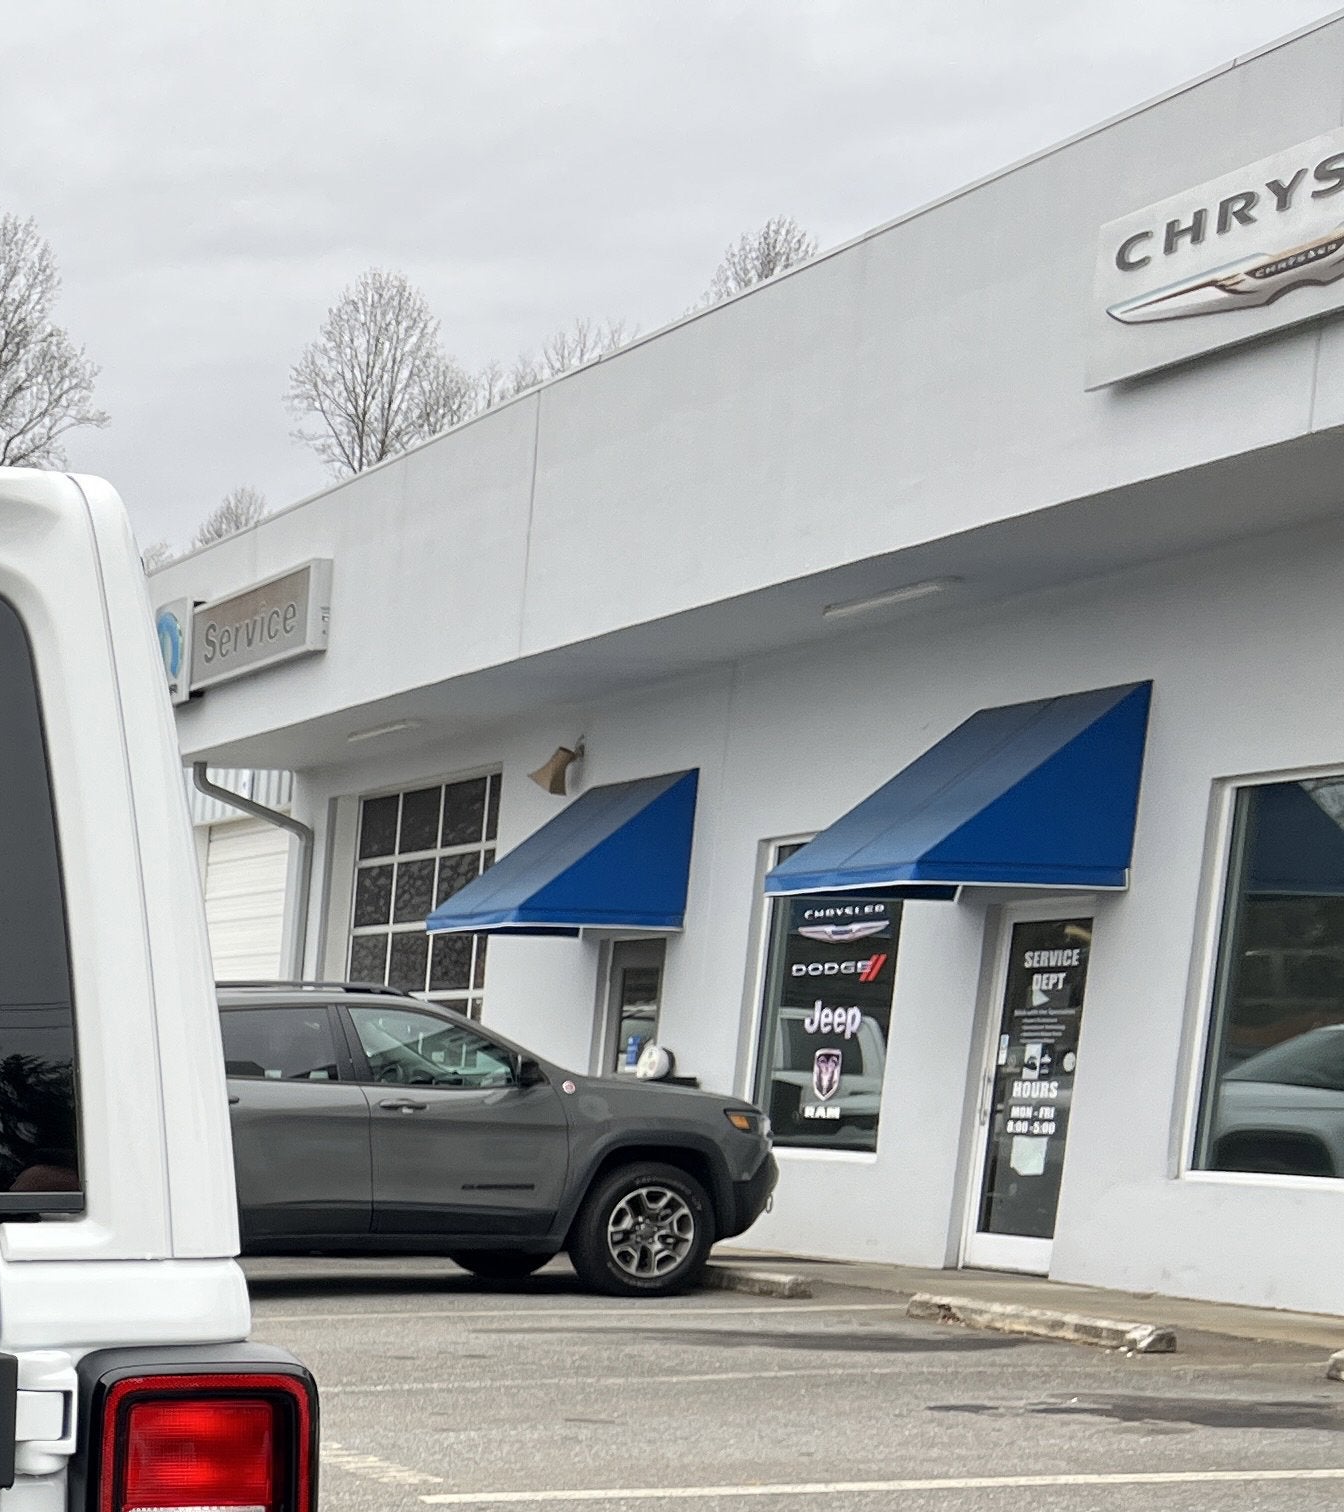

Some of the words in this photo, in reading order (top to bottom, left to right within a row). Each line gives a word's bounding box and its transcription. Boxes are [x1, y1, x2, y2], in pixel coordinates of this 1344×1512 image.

[203, 601, 298, 664] Service
[1024, 948, 1081, 969] SERVICE
[792, 960, 872, 977] DODGE
[1032, 972, 1067, 991] DEPT
[804, 1000, 862, 1039] Jeep
[1012, 1080, 1059, 1098] HOURS
[804, 1106, 840, 1119] RAM
[1010, 1105, 1033, 1119] MON
[1038, 1106, 1055, 1119] FRI
